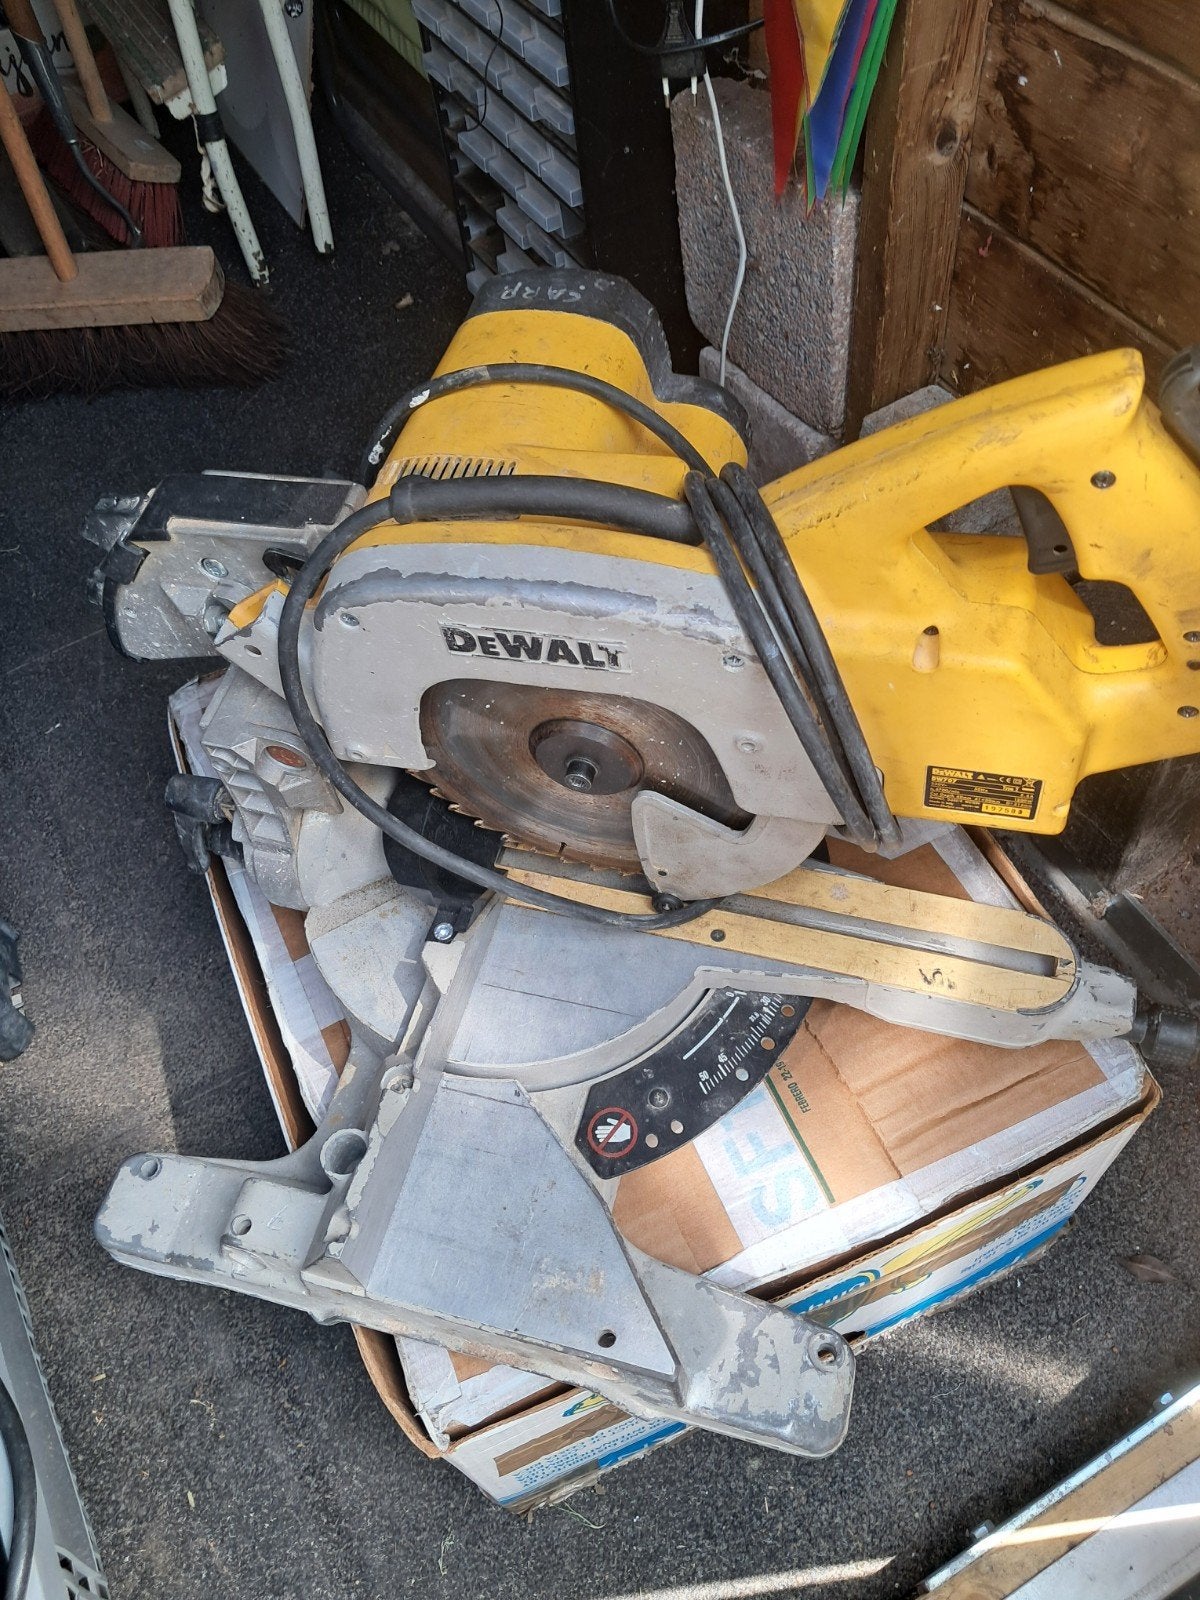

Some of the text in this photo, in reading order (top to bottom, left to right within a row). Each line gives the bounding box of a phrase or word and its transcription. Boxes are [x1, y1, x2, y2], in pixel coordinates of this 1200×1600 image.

[760, 995, 771, 1006] 30
[718, 1052, 728, 1063] 45
[698, 1070, 710, 1081] 50
[787, 1081, 812, 1114] FEBRERO
